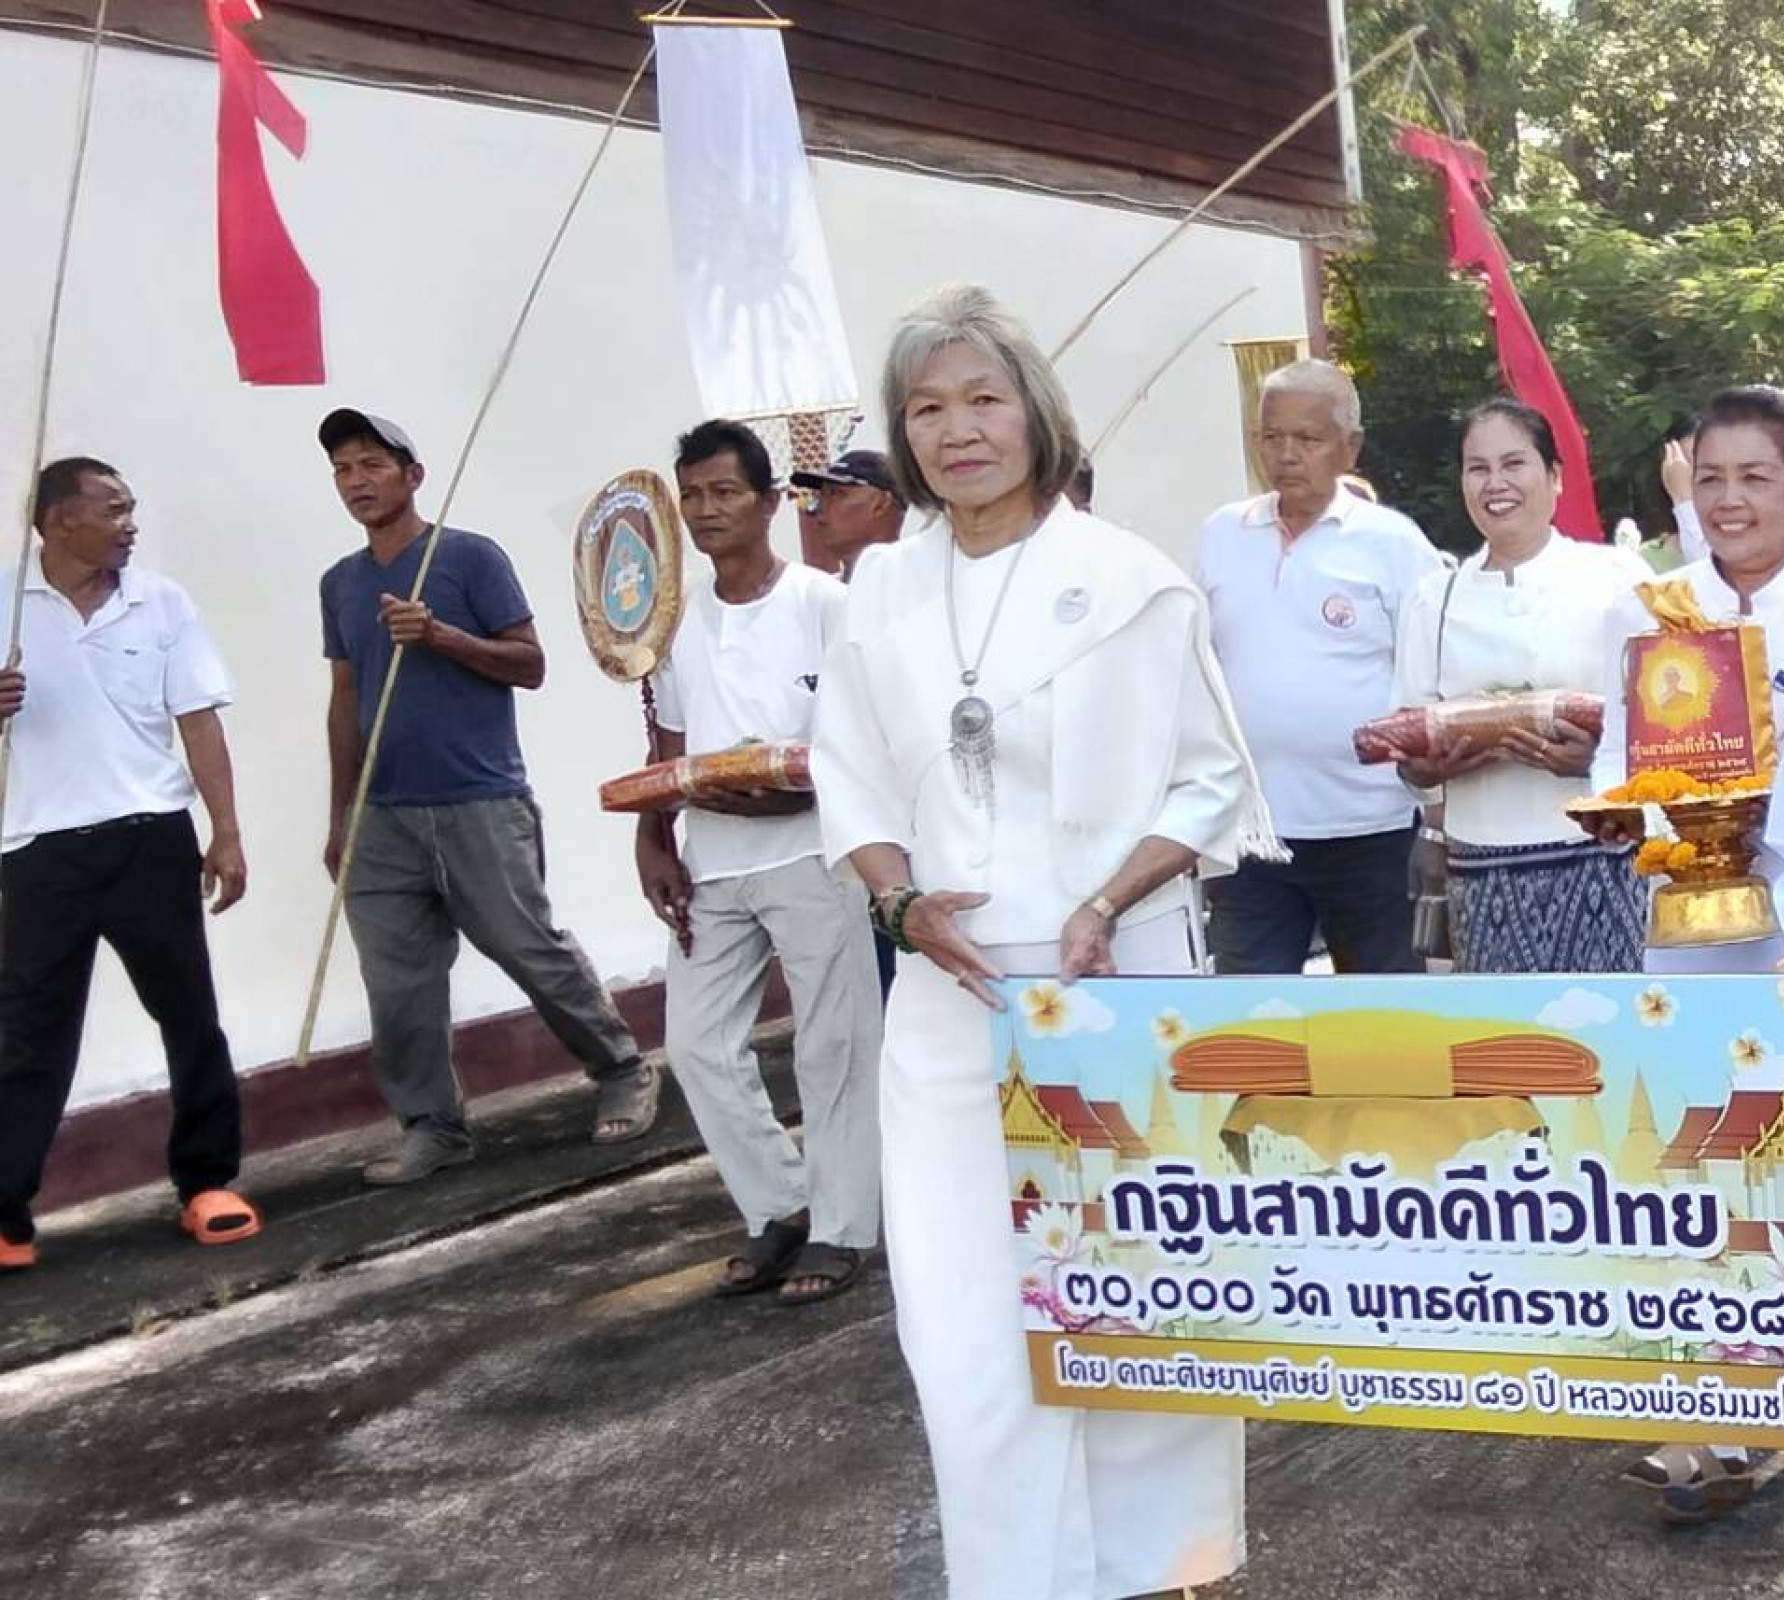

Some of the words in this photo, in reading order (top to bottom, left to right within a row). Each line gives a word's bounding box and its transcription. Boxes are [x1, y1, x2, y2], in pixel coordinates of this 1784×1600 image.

[1111, 1147, 1718, 1254] กฐินสามัคคีทั่วไทย
[1066, 1272, 1255, 1321] ๓๐,๐๐๐
[1270, 1265, 1332, 1317] วัด
[1347, 1271, 1610, 1334] พุทธศักราช
[1058, 1345, 1106, 1383] โดย
[1117, 1357, 1330, 1401] คณะศิษยานุศิษย์
[1339, 1373, 1464, 1407] บูชาธรรม
[1475, 1377, 1525, 1407] ๘๑
[1532, 1372, 1556, 1408] ปี
